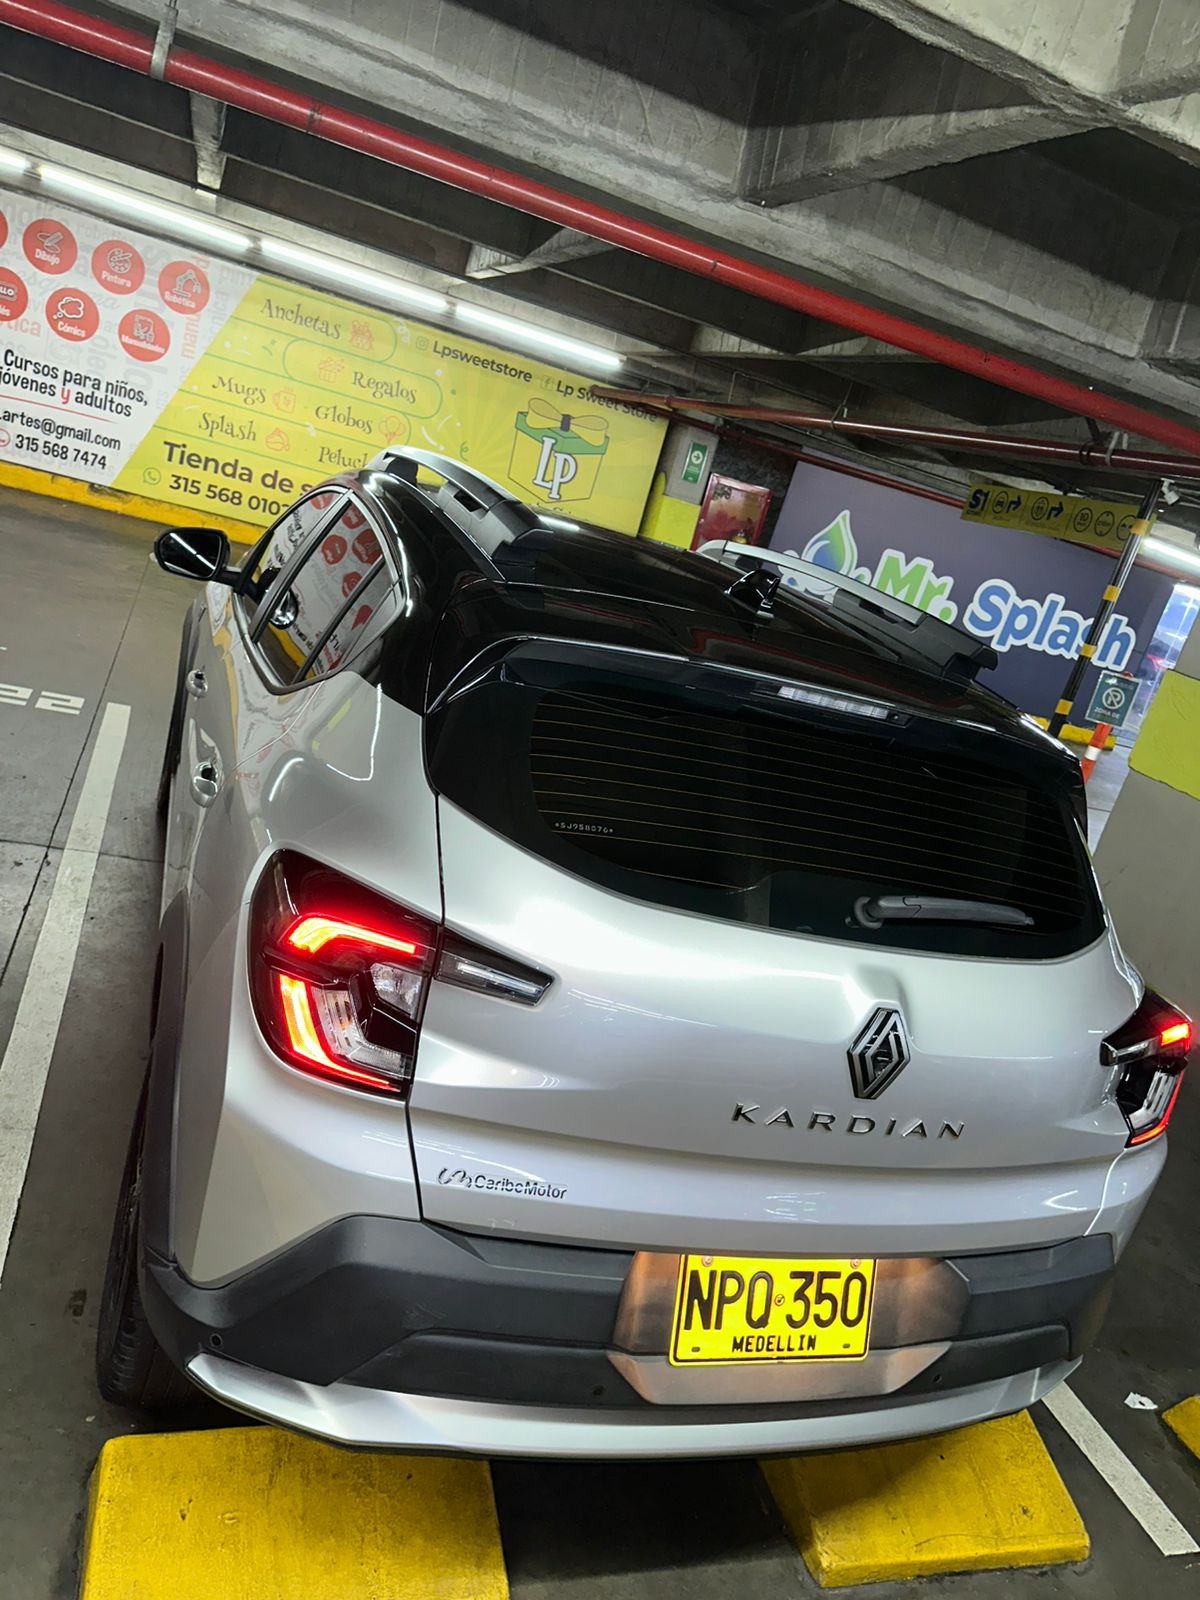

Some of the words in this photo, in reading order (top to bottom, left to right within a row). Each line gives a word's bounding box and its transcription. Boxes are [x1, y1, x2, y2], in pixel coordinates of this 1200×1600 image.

[34, 248, 61, 266] Dibujo
[101, 269, 132, 288] Pintura
[57, 319, 87, 339] Cómics
[260, 298, 342, 340] Anchetas
[4, 349, 59, 380] Cursos
[63, 369, 100, 391] para
[105, 380, 148, 407] niños,
[432, 341, 533, 383] Lpsweetstore
[0, 367, 56, 397] jóvenes
[60, 388, 71, 405] y
[75, 391, 132, 418] adultos
[211, 375, 267, 406] Mugs
[352, 371, 417, 404] Regalos
[556, 379, 574, 397] Lp
[577, 387, 619, 412] Sweet
[621, 403, 658, 424] Store
[198, 411, 257, 442] Splash
[315, 404, 373, 435] Globos
[15, 434, 39, 453] 315
[42, 440, 70, 460] 568
[73, 449, 107, 470] 7474
[163, 440, 253, 483] Tienda
[261, 469, 294, 494] de
[532, 435, 578, 501] LP
[169, 474, 202, 495] 315
[205, 483, 243, 506] 568
[248, 494, 291, 517] 010
[873, 550, 957, 624] Mr.
[731, 1102, 965, 1139] KARDIAN
[683, 1269, 774, 1331] NPQ
[786, 1270, 868, 1330] 350
[732, 1333, 817, 1353] MEDELLIN
